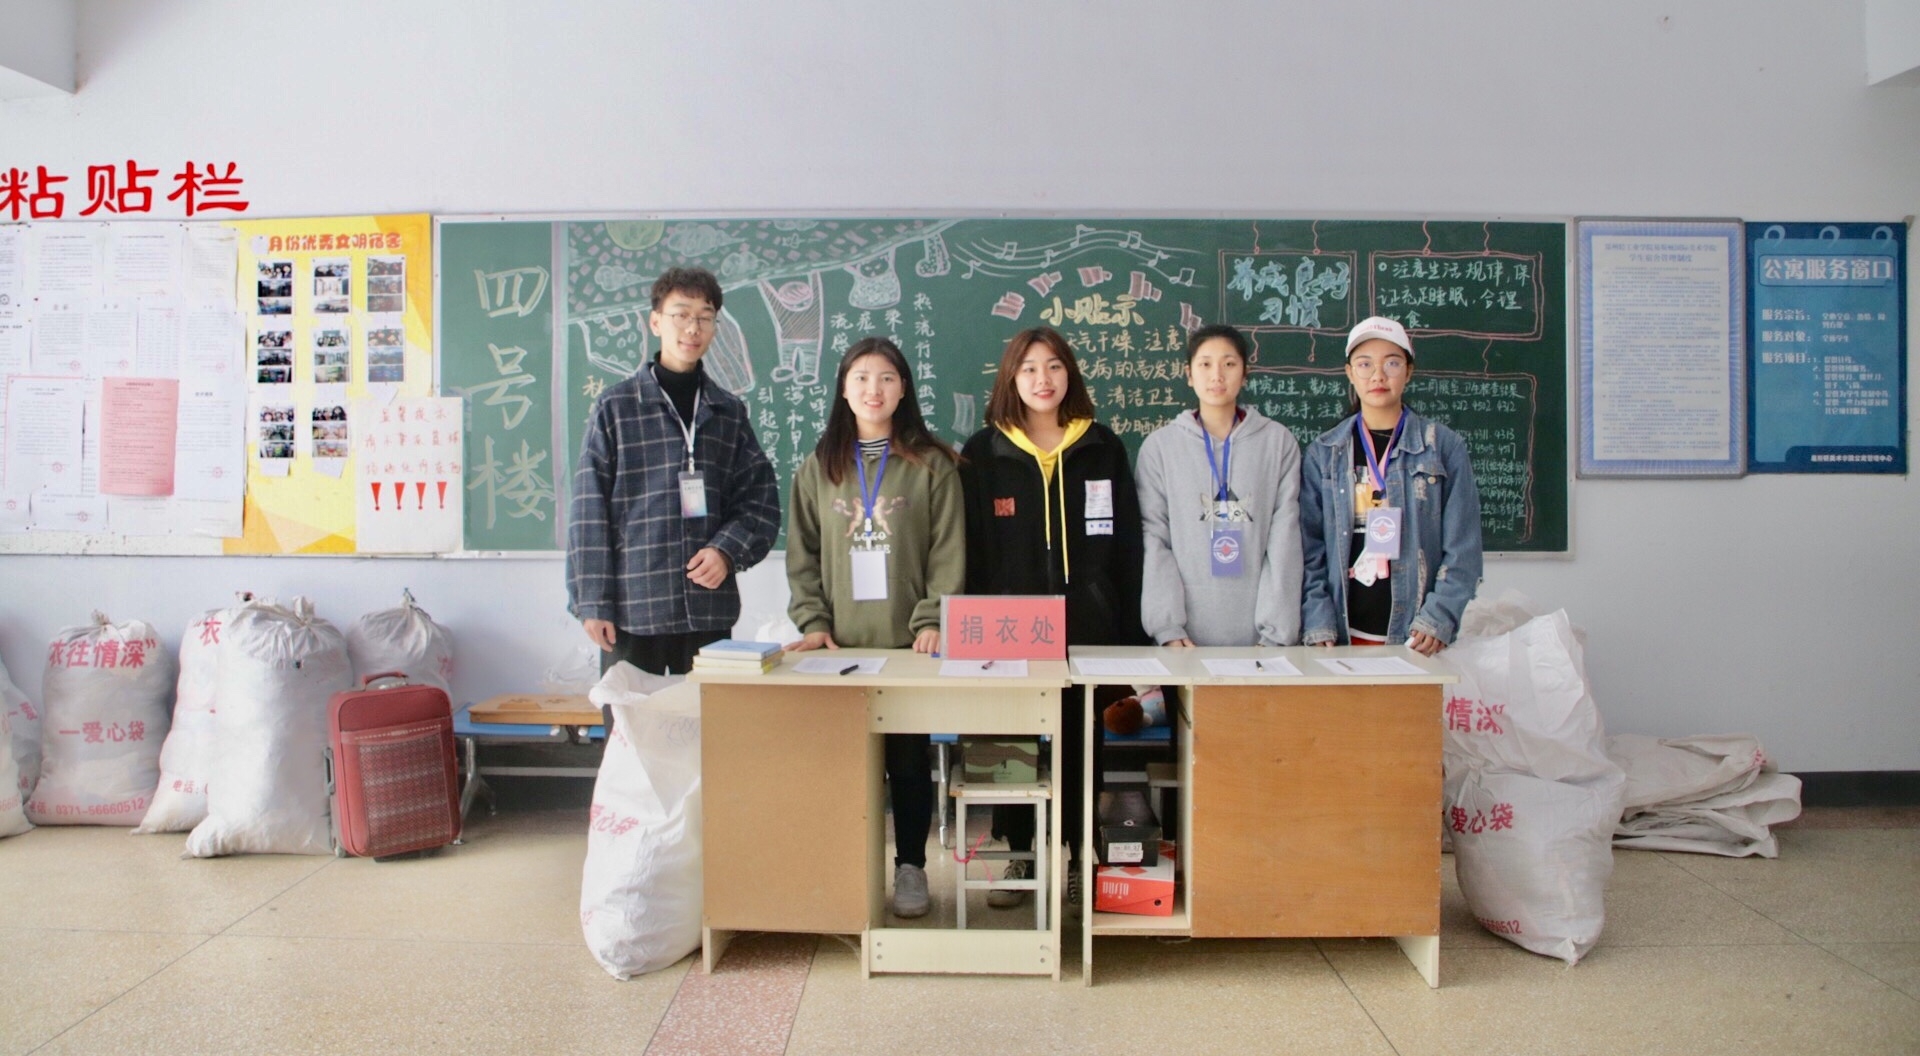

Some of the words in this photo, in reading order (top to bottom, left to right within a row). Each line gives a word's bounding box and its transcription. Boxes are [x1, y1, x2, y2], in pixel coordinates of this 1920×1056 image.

[0, 159, 249, 220] 粘贴栏
[1227, 257, 1350, 300] 养成良好
[1763, 258, 1892, 281] 公寓服务窗口
[1258, 299, 1321, 329] 习惯
[1762, 331, 1812, 343] 服务对象：
[465, 264, 557, 530] 四号楼
[960, 614, 1055, 645] 捐衣处
[1450, 803, 1514, 844] 爱心袋
